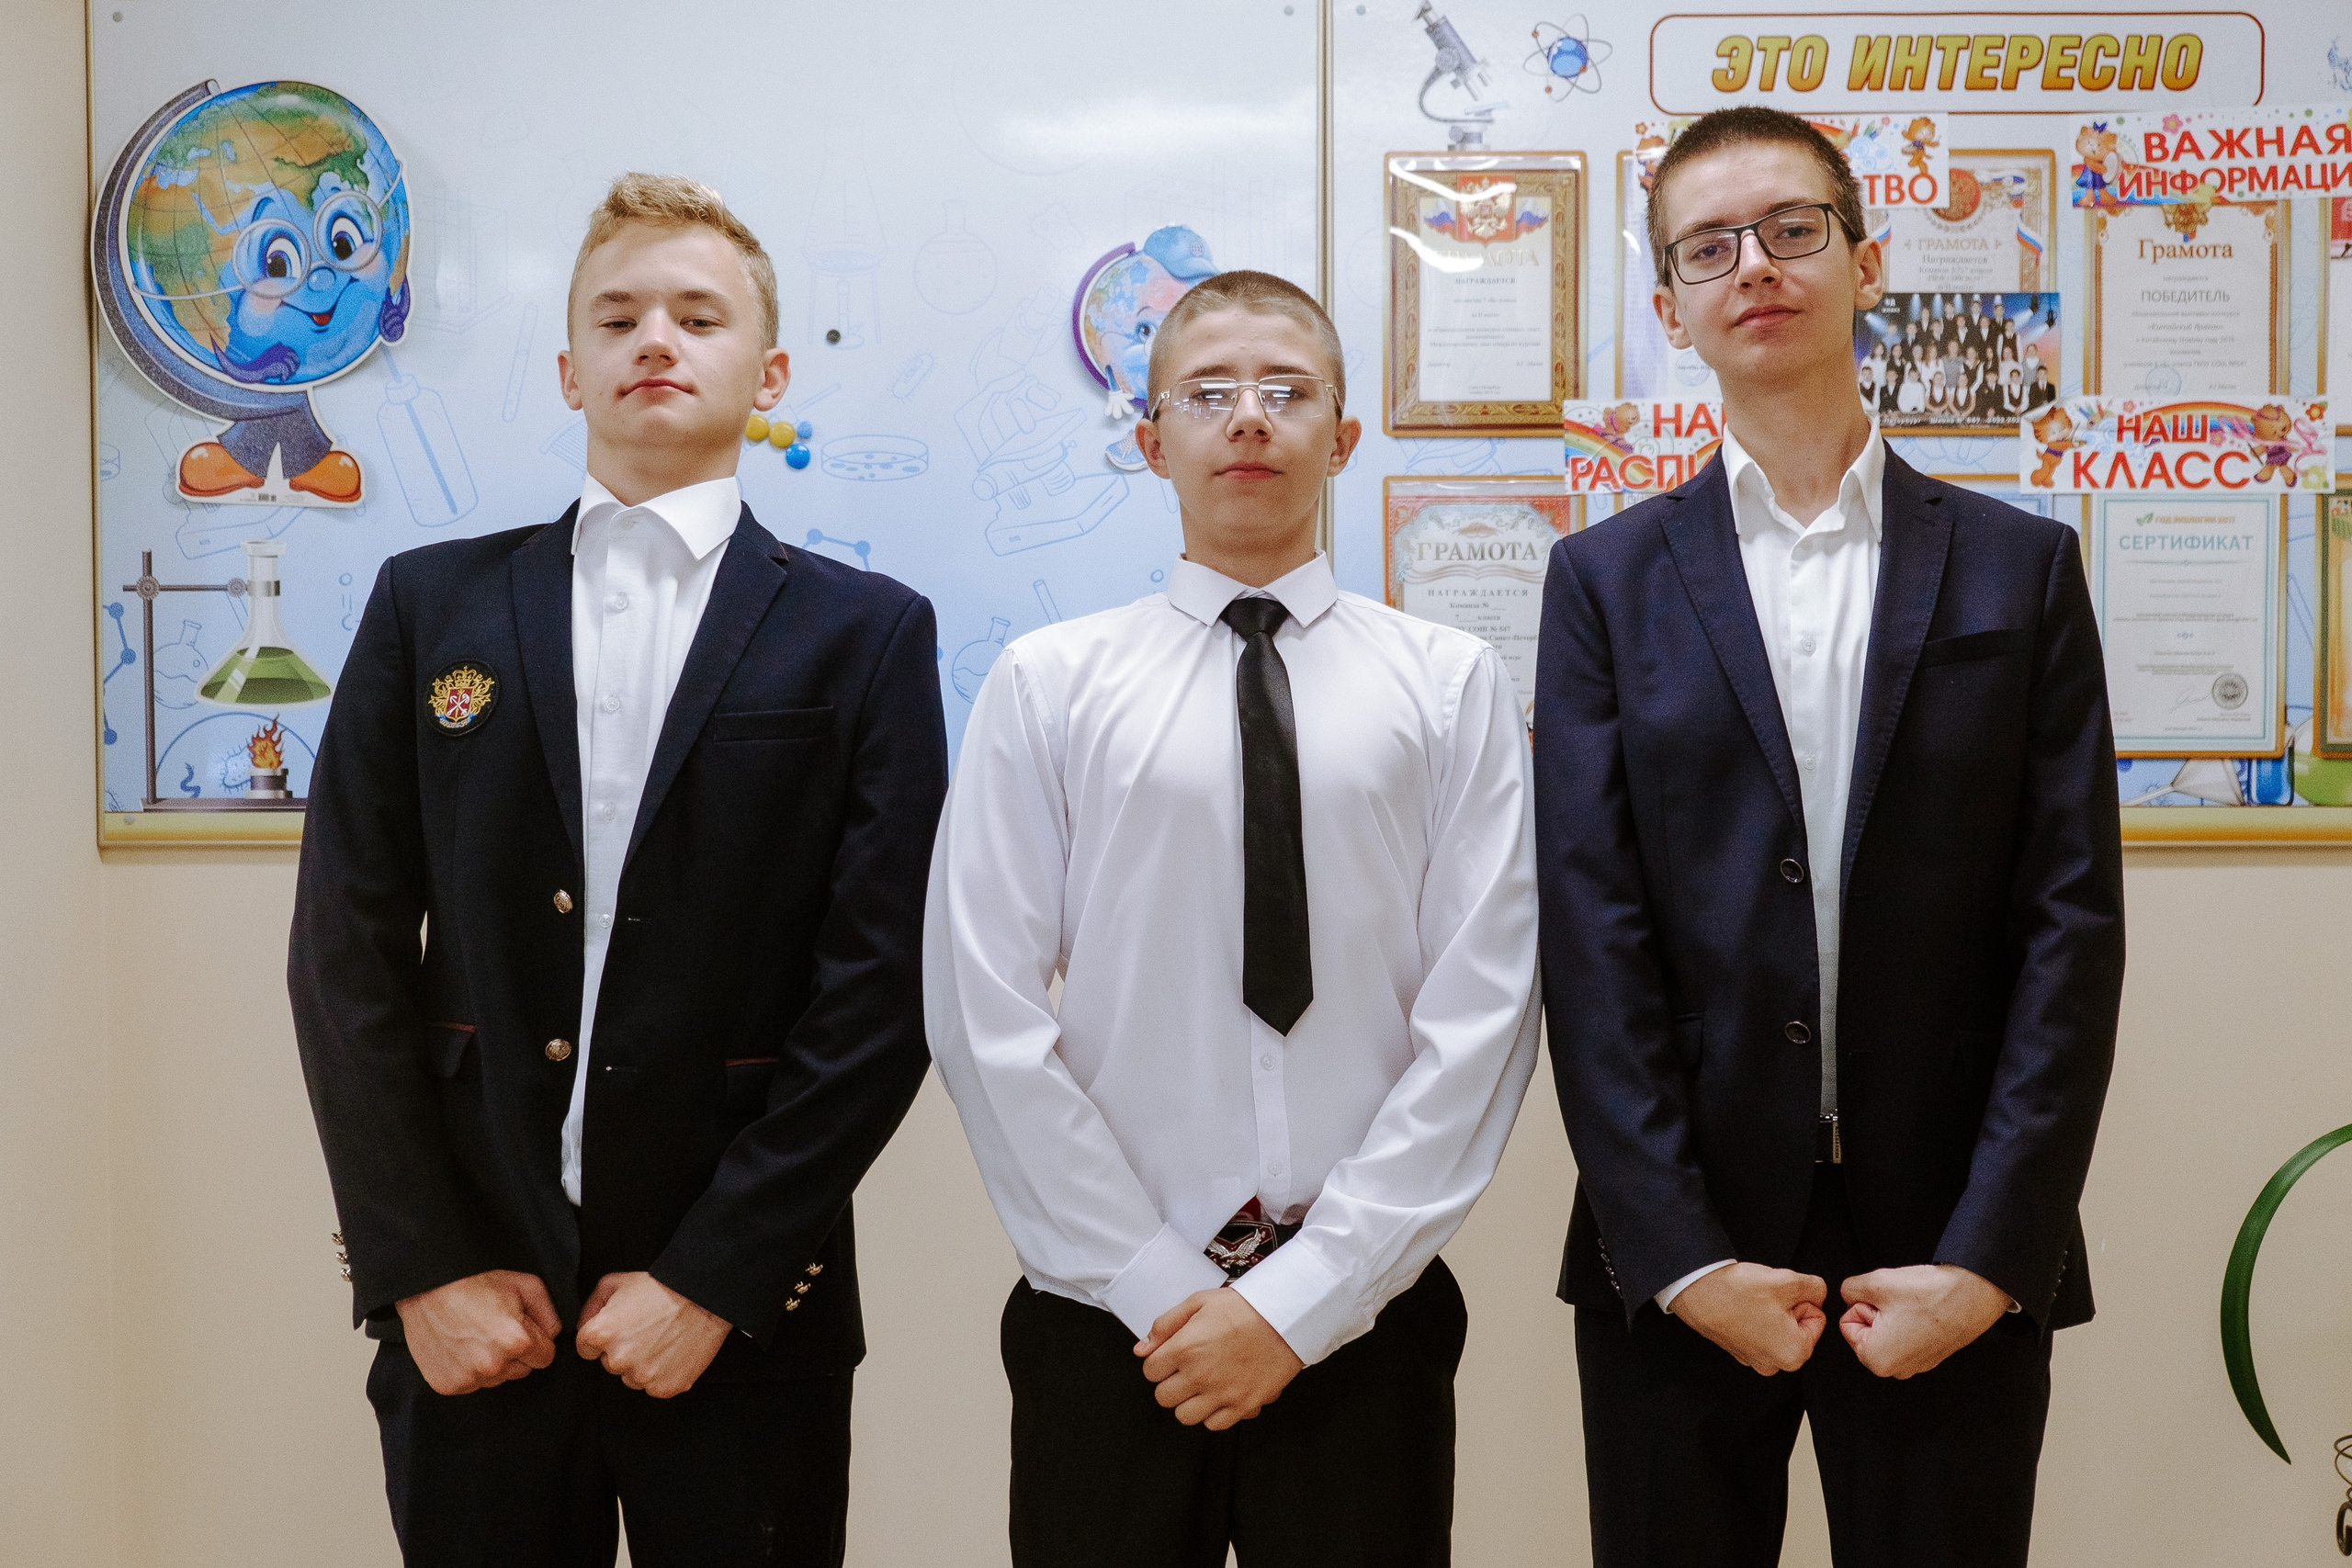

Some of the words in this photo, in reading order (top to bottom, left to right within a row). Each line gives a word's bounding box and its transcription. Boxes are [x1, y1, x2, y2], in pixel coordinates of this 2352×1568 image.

[1712, 35, 1829, 92] ЭТО
[1847, 34, 2204, 91] ИНТЕРЕСНО
[2143, 123, 2352, 163] ВАЖНАЯ
[1863, 174, 1938, 205] ТВО
[1917, 238, 1989, 250] ГРАМОТА
[2138, 239, 2233, 265] Грамота
[2142, 289, 2231, 304] ПОБЕДИТЕЛЬ
[1653, 403, 1727, 438] НА
[2117, 414, 2208, 443] НАШ
[2073, 451, 2250, 489] КЛАСС
[1416, 541, 1539, 561] ГРАМОТА
[2119, 535, 2254, 550] СЕРТИФИКАТ
